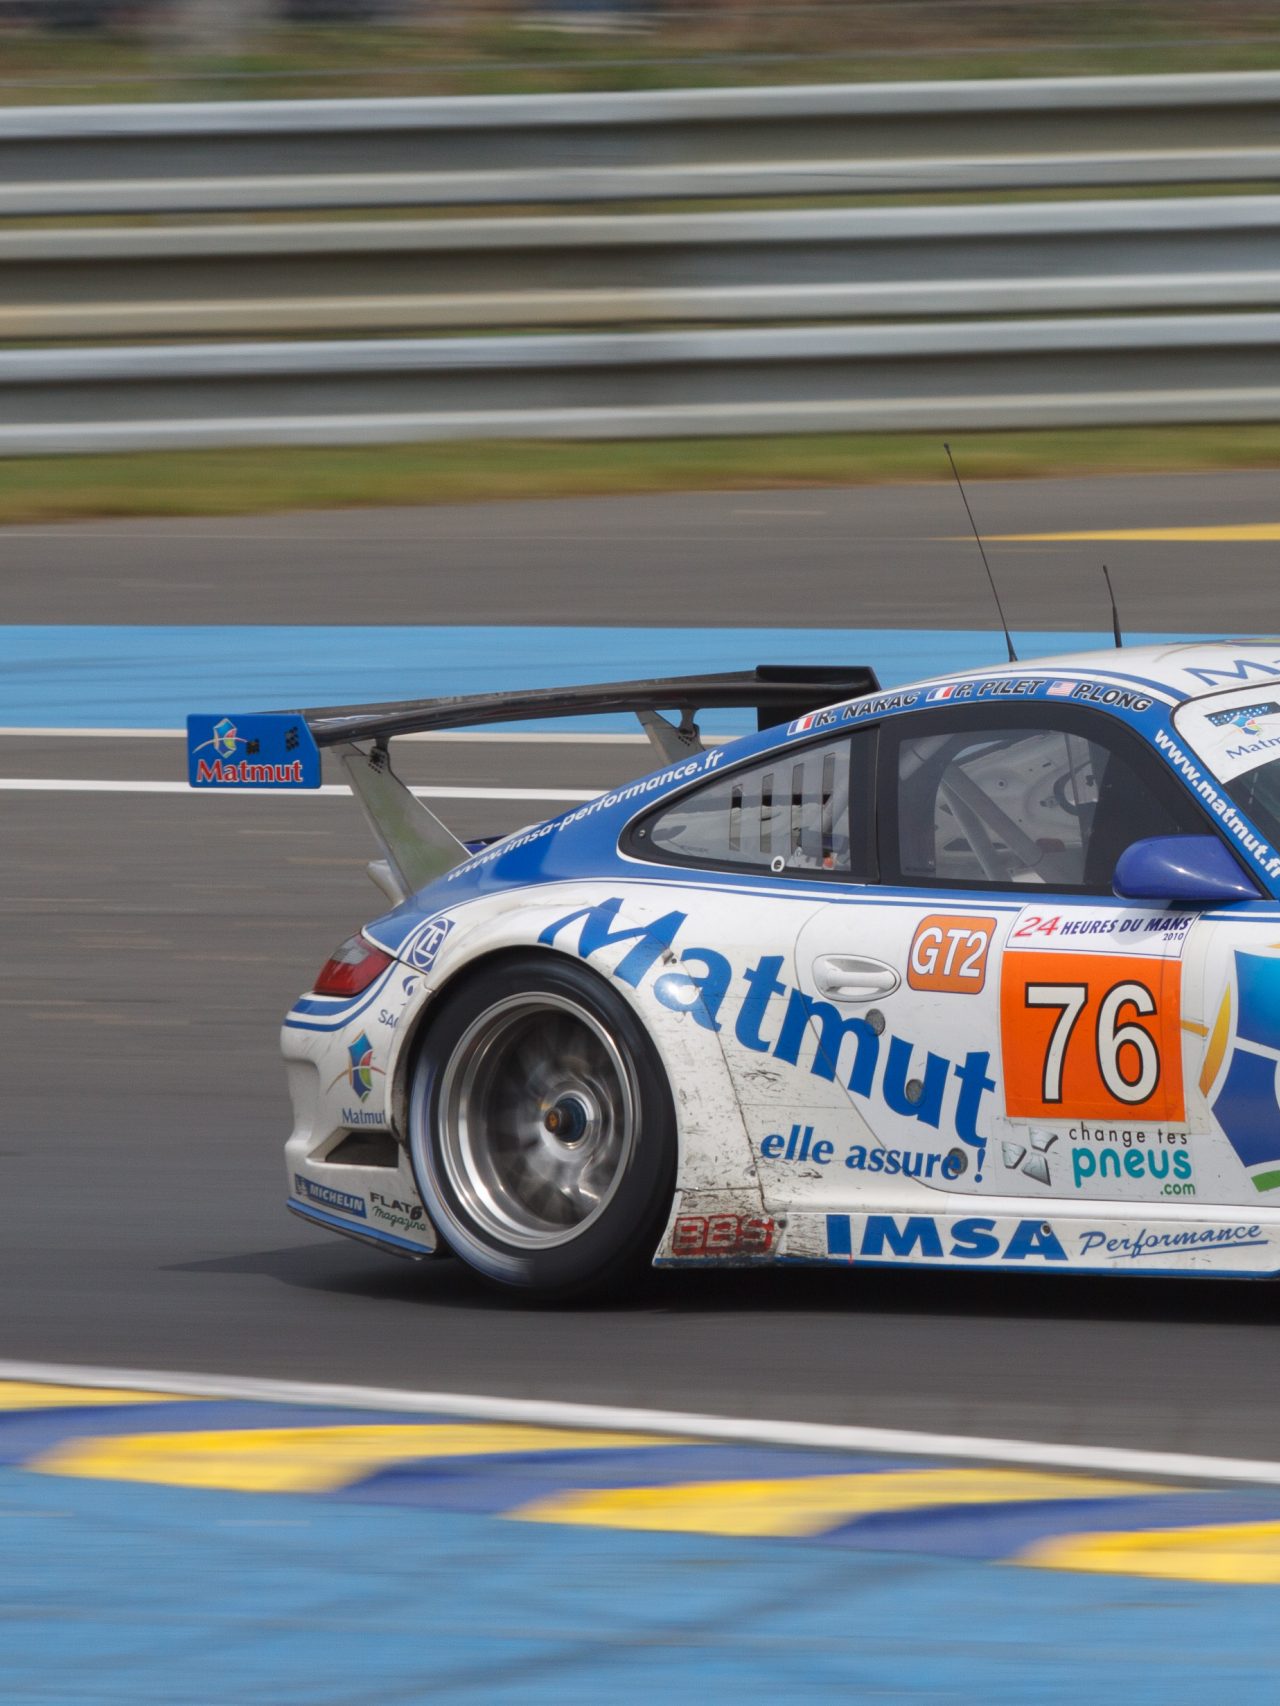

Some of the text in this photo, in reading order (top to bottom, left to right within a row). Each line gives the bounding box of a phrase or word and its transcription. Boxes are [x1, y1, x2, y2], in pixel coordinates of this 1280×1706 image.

[977, 680, 1045, 696] PILET
[842, 691, 922, 720] NARAC
[197, 759, 303, 782] Matmut
[448, 750, 724, 881] www.imsa-performance.fr
[415, 924, 446, 957] ZF
[1013, 916, 1192, 938] 24 HEURES DU MANS
[1163, 933, 1184, 941] 2010
[911, 926, 987, 979] GT2
[537, 897, 996, 1148] Matmut
[1025, 979, 1161, 1106] 76
[1069, 1121, 1188, 1147] change tes
[760, 1125, 834, 1164] elle
[845, 1145, 962, 1181] assure
[1072, 1147, 1192, 1188] pneus
[310, 1184, 363, 1211] MICHELIN
[1160, 1181, 1196, 1195] .com
[672, 1214, 774, 1255] BBS
[826, 1213, 1068, 1261] IMSA
[1079, 1223, 1264, 1258] Performance
